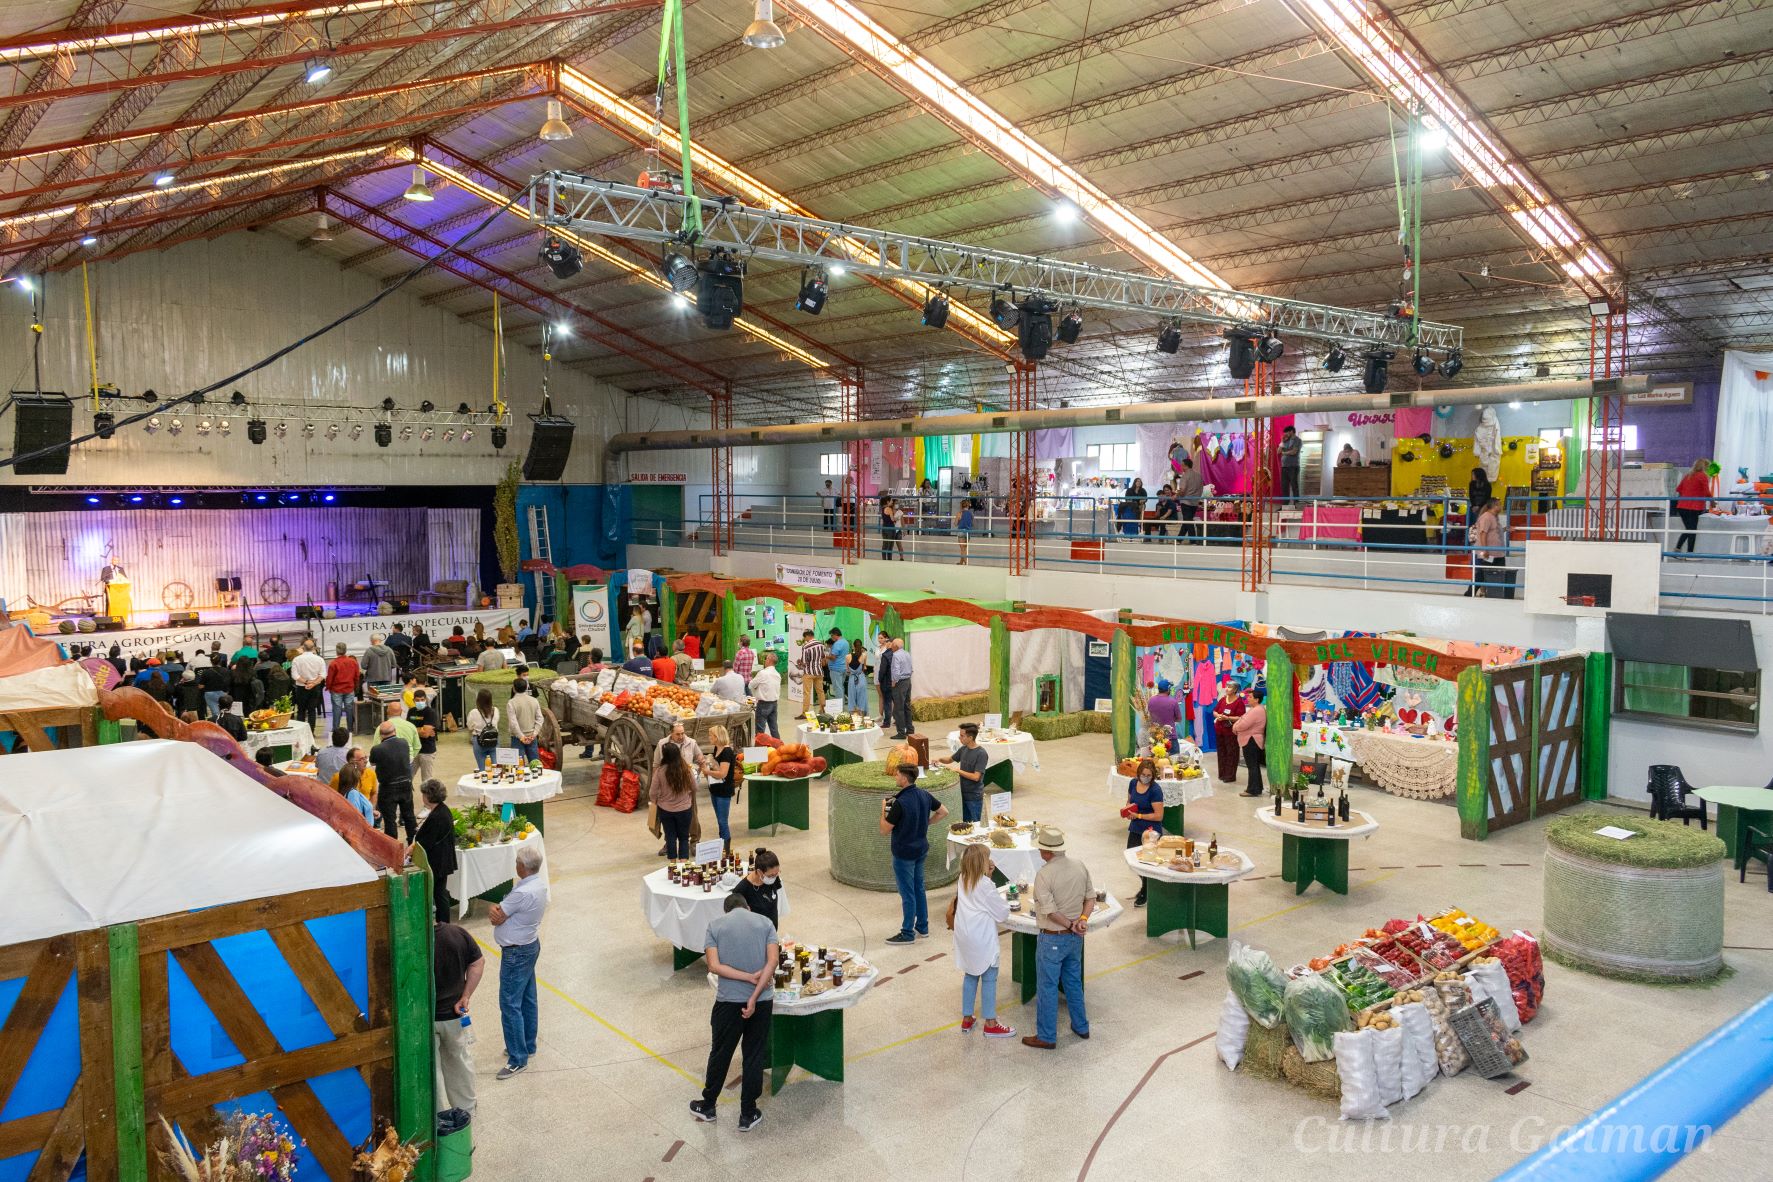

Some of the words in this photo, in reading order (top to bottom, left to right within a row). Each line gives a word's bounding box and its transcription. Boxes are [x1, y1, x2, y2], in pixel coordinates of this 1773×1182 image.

[631, 473, 648, 482] SALIDA
[650, 473, 657, 482] DE
[658, 473, 687, 482] EMERGENCIA
[329, 621, 387, 633] MUESTRA
[390, 616, 480, 631] AGROPECUARIA
[113, 631, 227, 649] AGROPECUARIA
[1162, 625, 1248, 651] MUJERES
[1316, 642, 1353, 660] DEL
[1371, 640, 1438, 672] VIRCH
